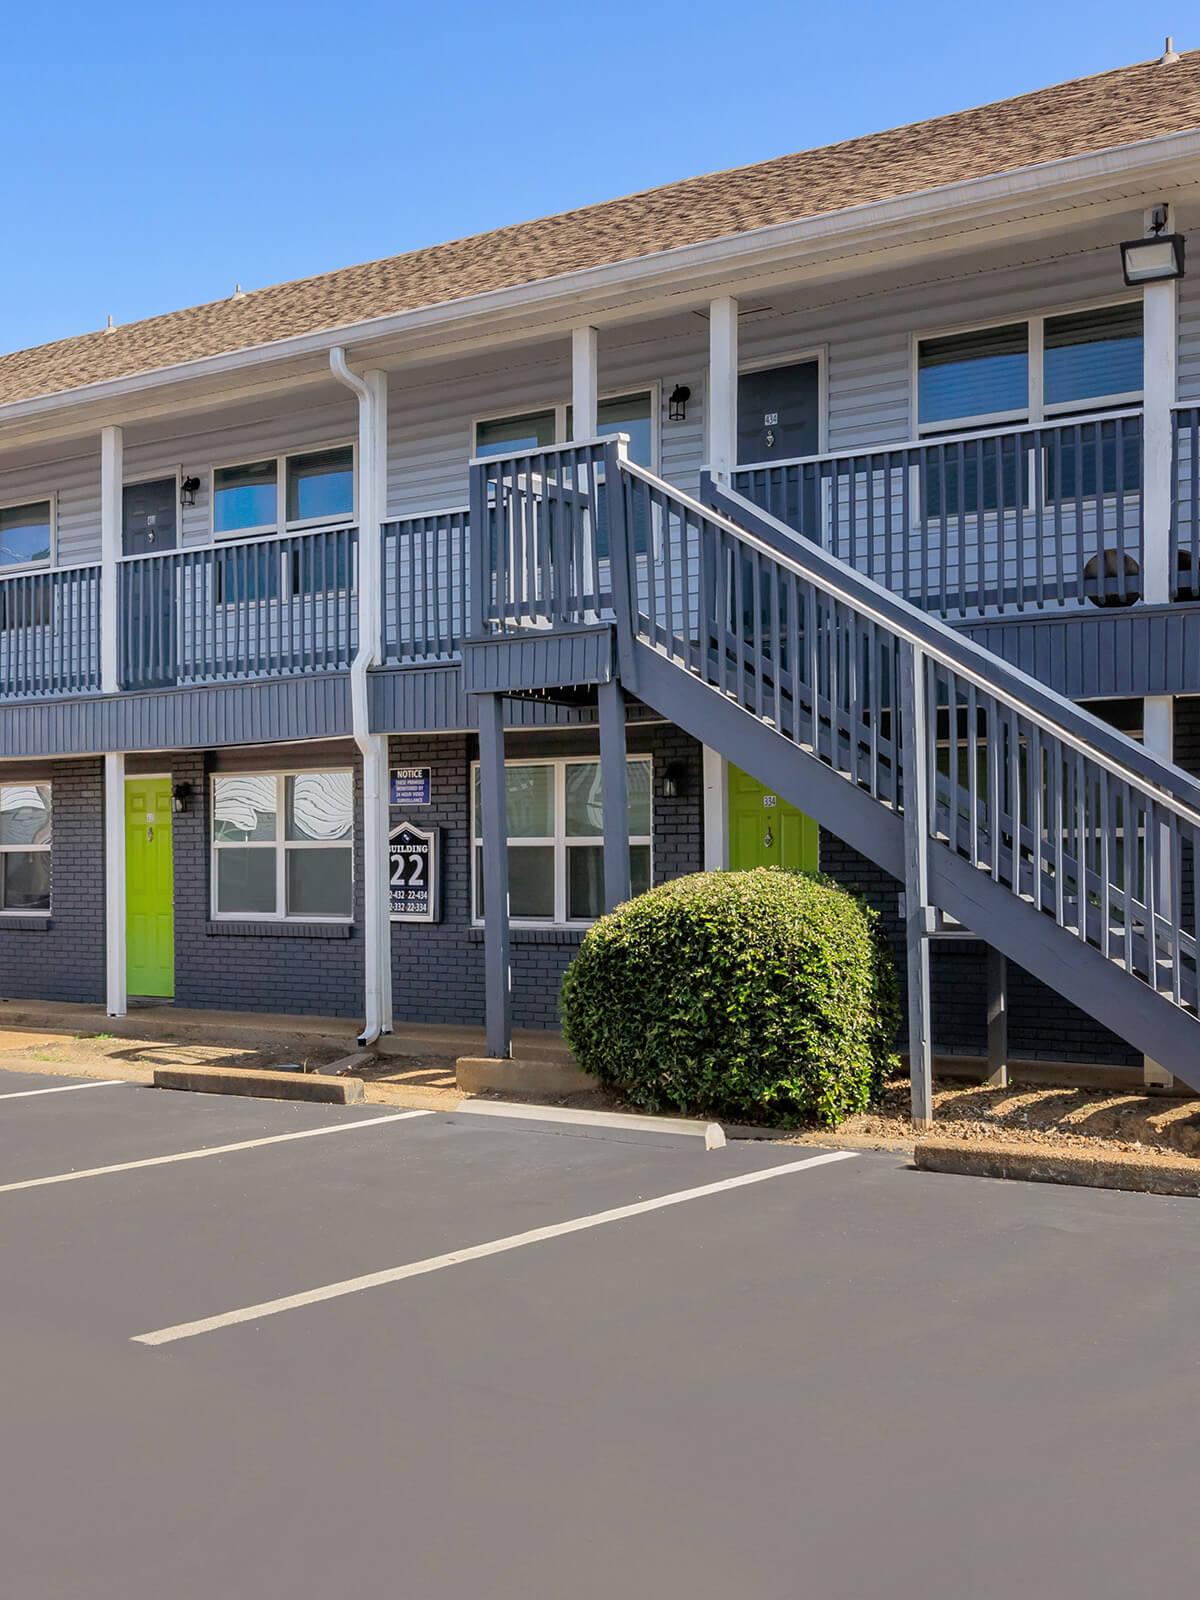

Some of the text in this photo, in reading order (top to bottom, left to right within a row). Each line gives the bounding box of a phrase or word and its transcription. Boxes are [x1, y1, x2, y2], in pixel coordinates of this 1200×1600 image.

[397, 770, 423, 778] NOTICE
[390, 854, 424, 886] 22
[389, 890, 428, 899] 2-432 22-434
[389, 902, 427, 911] 2-332 22-334
